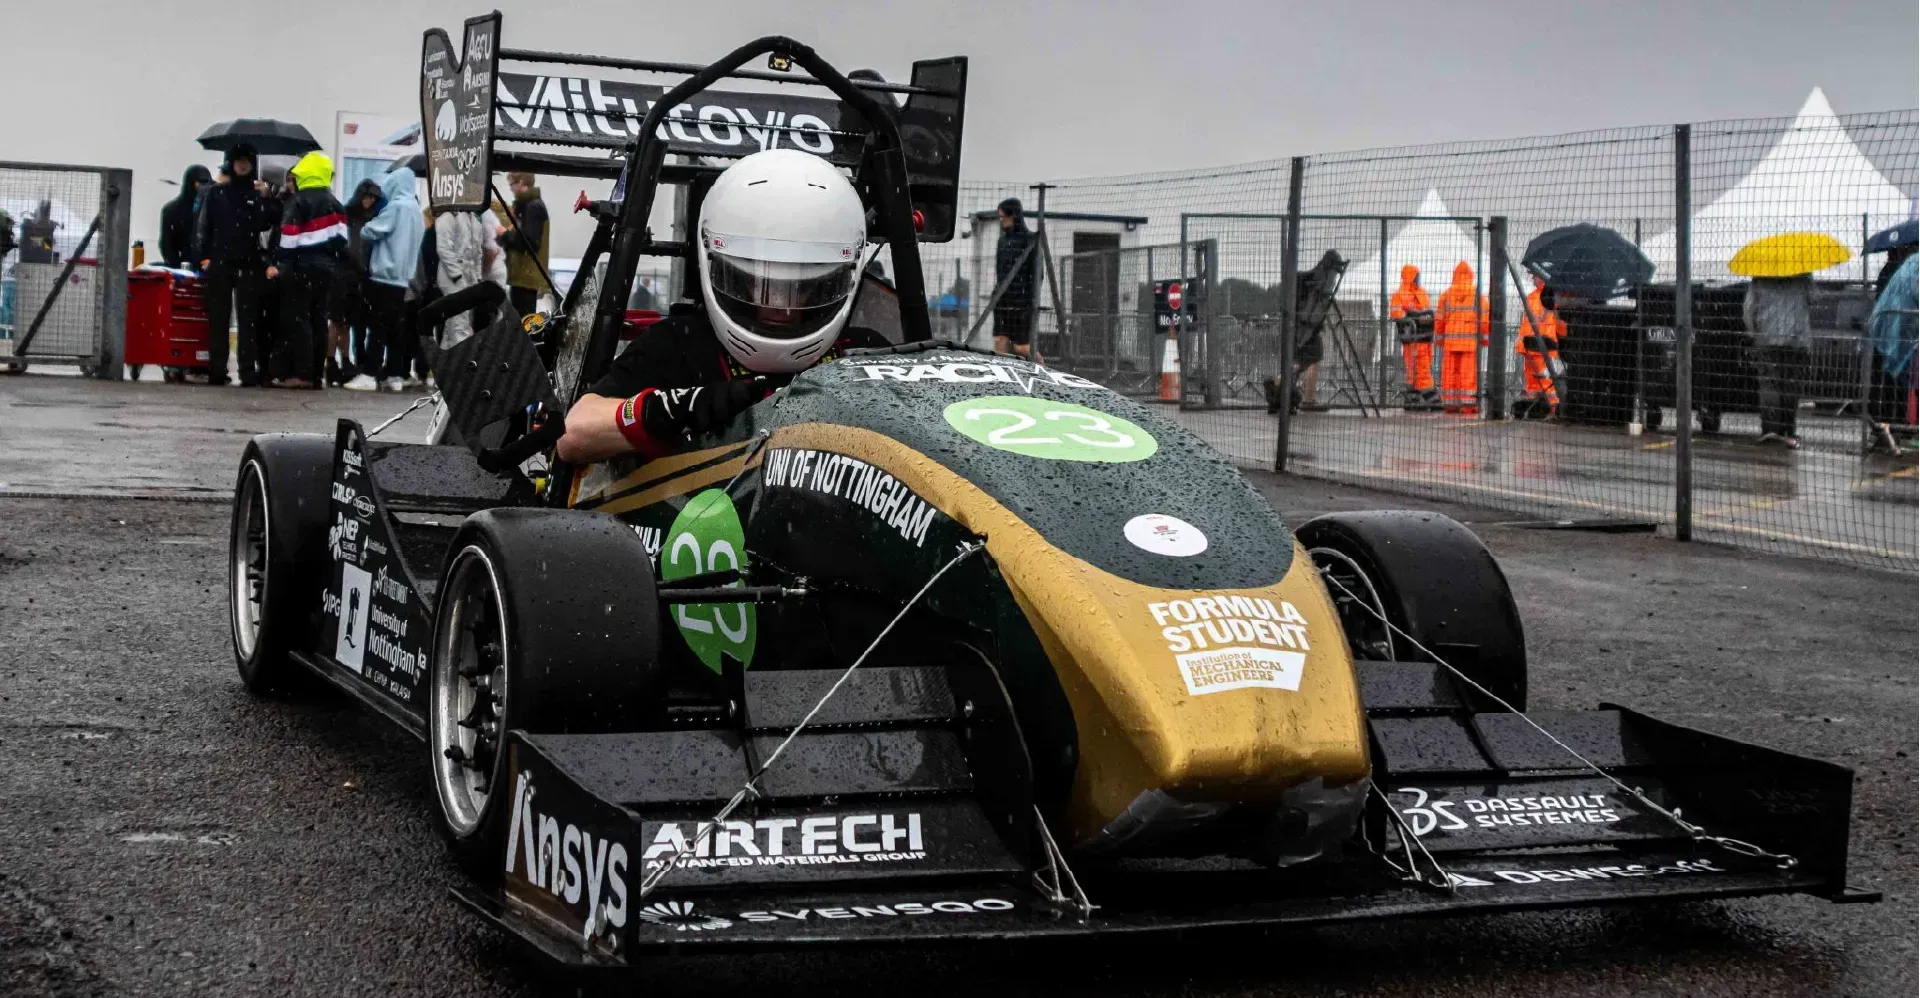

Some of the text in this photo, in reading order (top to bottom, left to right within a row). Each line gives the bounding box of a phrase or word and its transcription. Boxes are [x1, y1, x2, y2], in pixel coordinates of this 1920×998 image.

[431, 167, 464, 204] Ansys
[964, 408, 1136, 448] 23
[765, 449, 937, 548] UNI OF NOTTINGHAM
[669, 532, 748, 643] 23
[371, 604, 408, 638] University of
[1148, 595, 1309, 626] FORMULA
[368, 627, 415, 675] Nottingham
[1162, 618, 1311, 652] STUDENT
[1186, 651, 1252, 666] Institution of
[1189, 659, 1284, 678] MECHANICAL
[1193, 671, 1275, 688] ENGINEERS
[1464, 794, 1606, 814] DASSAULT
[1474, 808, 1621, 828] SYSTEMES
[642, 813, 924, 861] AIRTECH
[505, 773, 628, 941] Ansys
[757, 853, 861, 866] MATERIALS
[863, 851, 927, 863] GROUP
[738, 898, 1016, 923] SVENSQO
